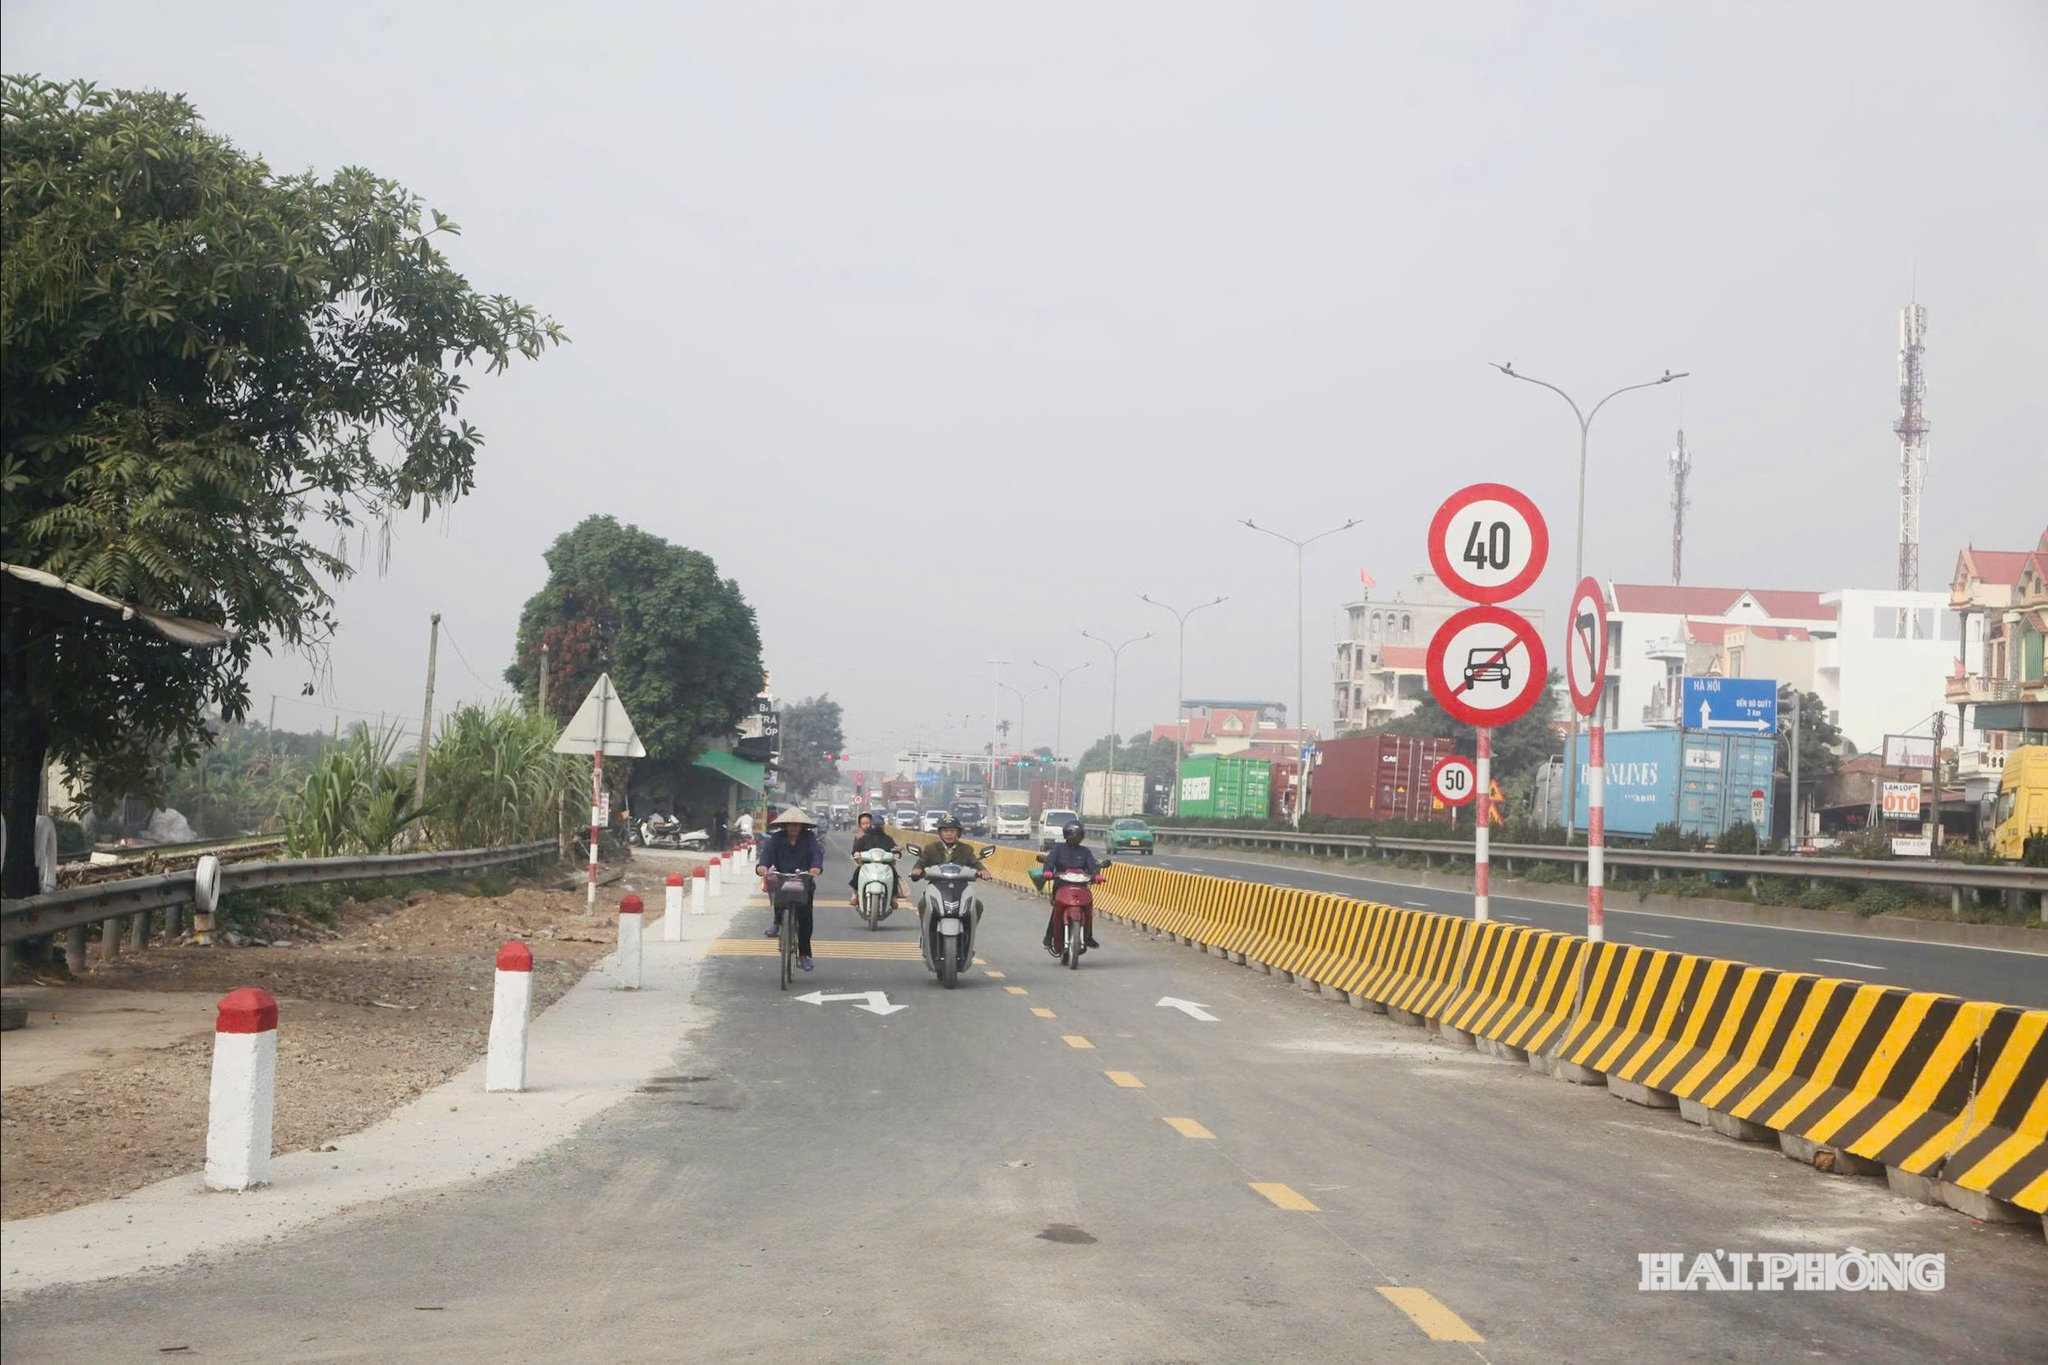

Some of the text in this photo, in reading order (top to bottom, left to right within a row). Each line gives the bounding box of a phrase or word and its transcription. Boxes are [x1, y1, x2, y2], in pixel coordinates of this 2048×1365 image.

[1463, 521, 1511, 570] 40
[1445, 770, 1465, 790] 50
[1884, 791, 1919, 812] ÔTÔ
